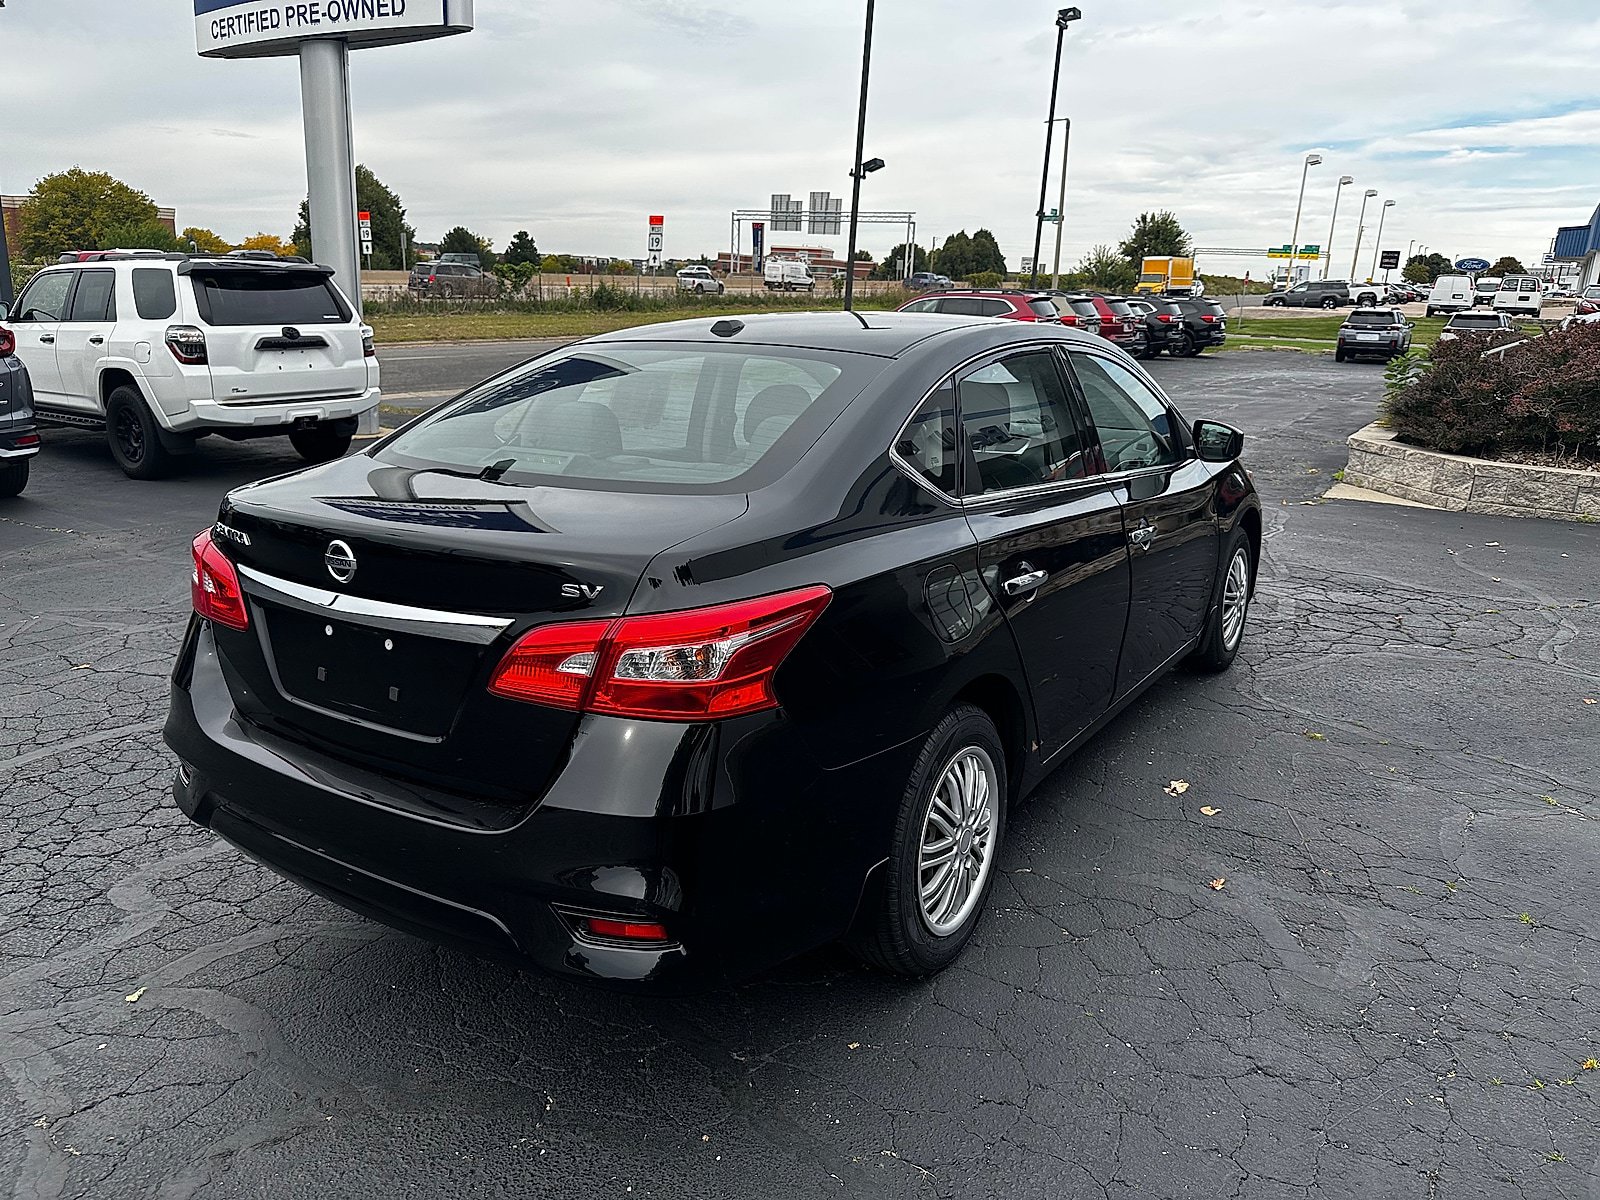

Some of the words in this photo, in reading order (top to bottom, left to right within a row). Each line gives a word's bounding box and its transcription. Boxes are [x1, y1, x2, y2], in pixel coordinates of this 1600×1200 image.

[211, 8, 280, 39] CERTIFIED
[285, 0, 405, 27] PRE-OWNED
[362, 229, 369, 238] 19
[651, 237, 660, 247] 19
[1462, 260, 1484, 269] Ford
[561, 583, 604, 599] SV
